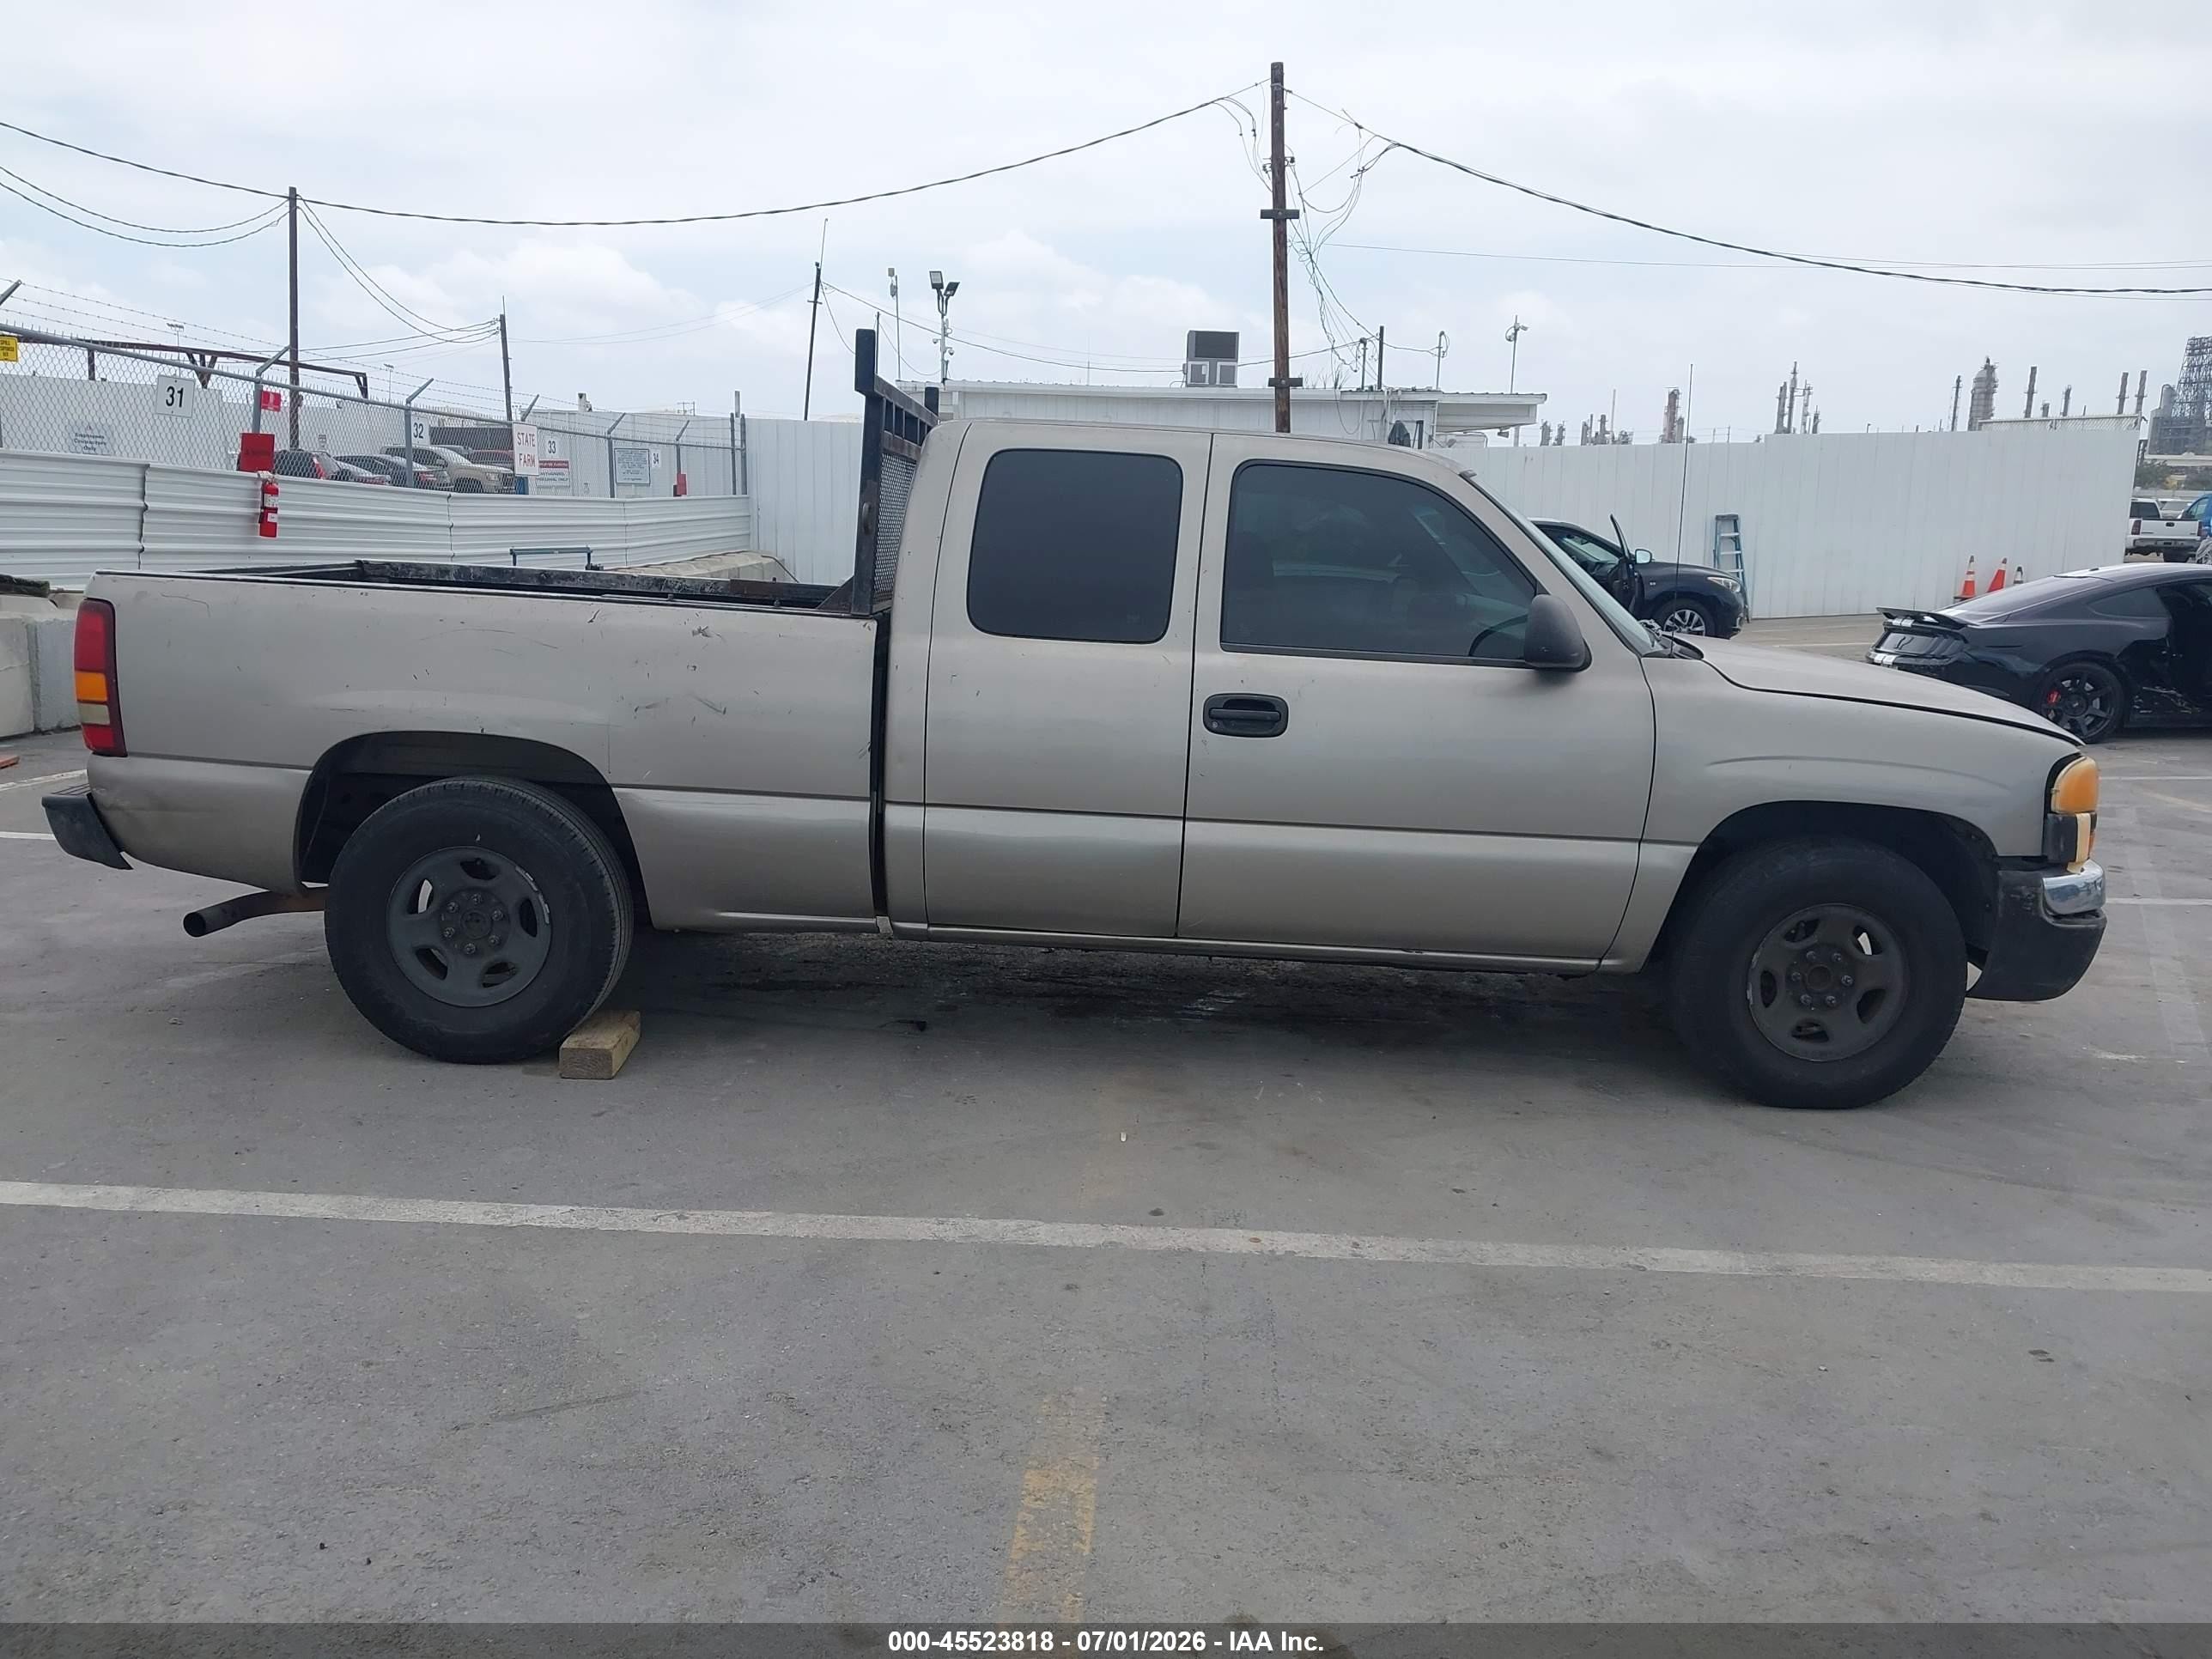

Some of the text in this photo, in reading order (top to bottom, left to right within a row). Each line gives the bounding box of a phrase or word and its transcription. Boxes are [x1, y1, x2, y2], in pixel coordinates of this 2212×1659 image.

[165, 386, 184, 408] 31
[413, 422, 424, 439] 32
[517, 433, 536, 447] STATE
[548, 440, 556, 453] 33
[519, 453, 536, 467] FARM
